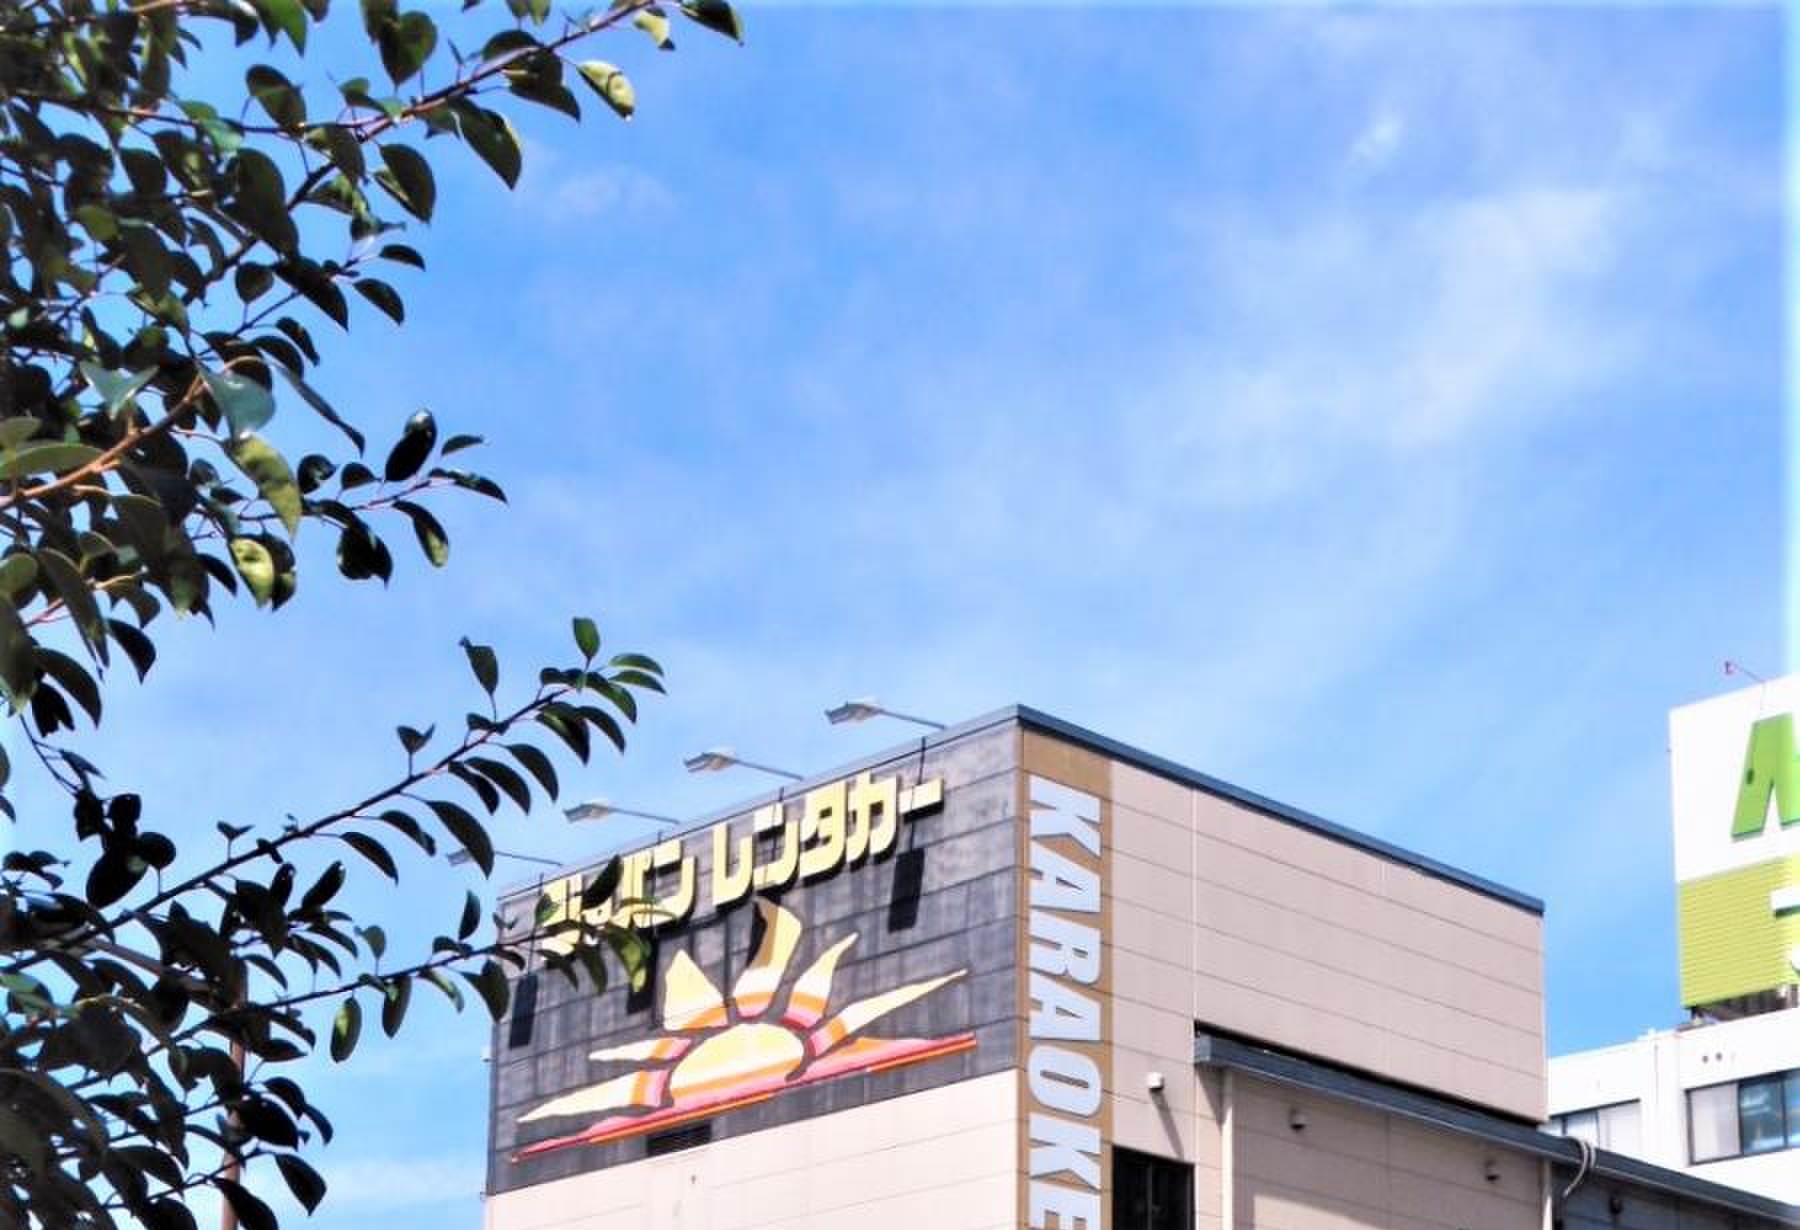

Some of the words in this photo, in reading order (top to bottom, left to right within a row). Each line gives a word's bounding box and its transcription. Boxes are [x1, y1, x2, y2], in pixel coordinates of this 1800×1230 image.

[712, 771, 943, 906] レンタカー
